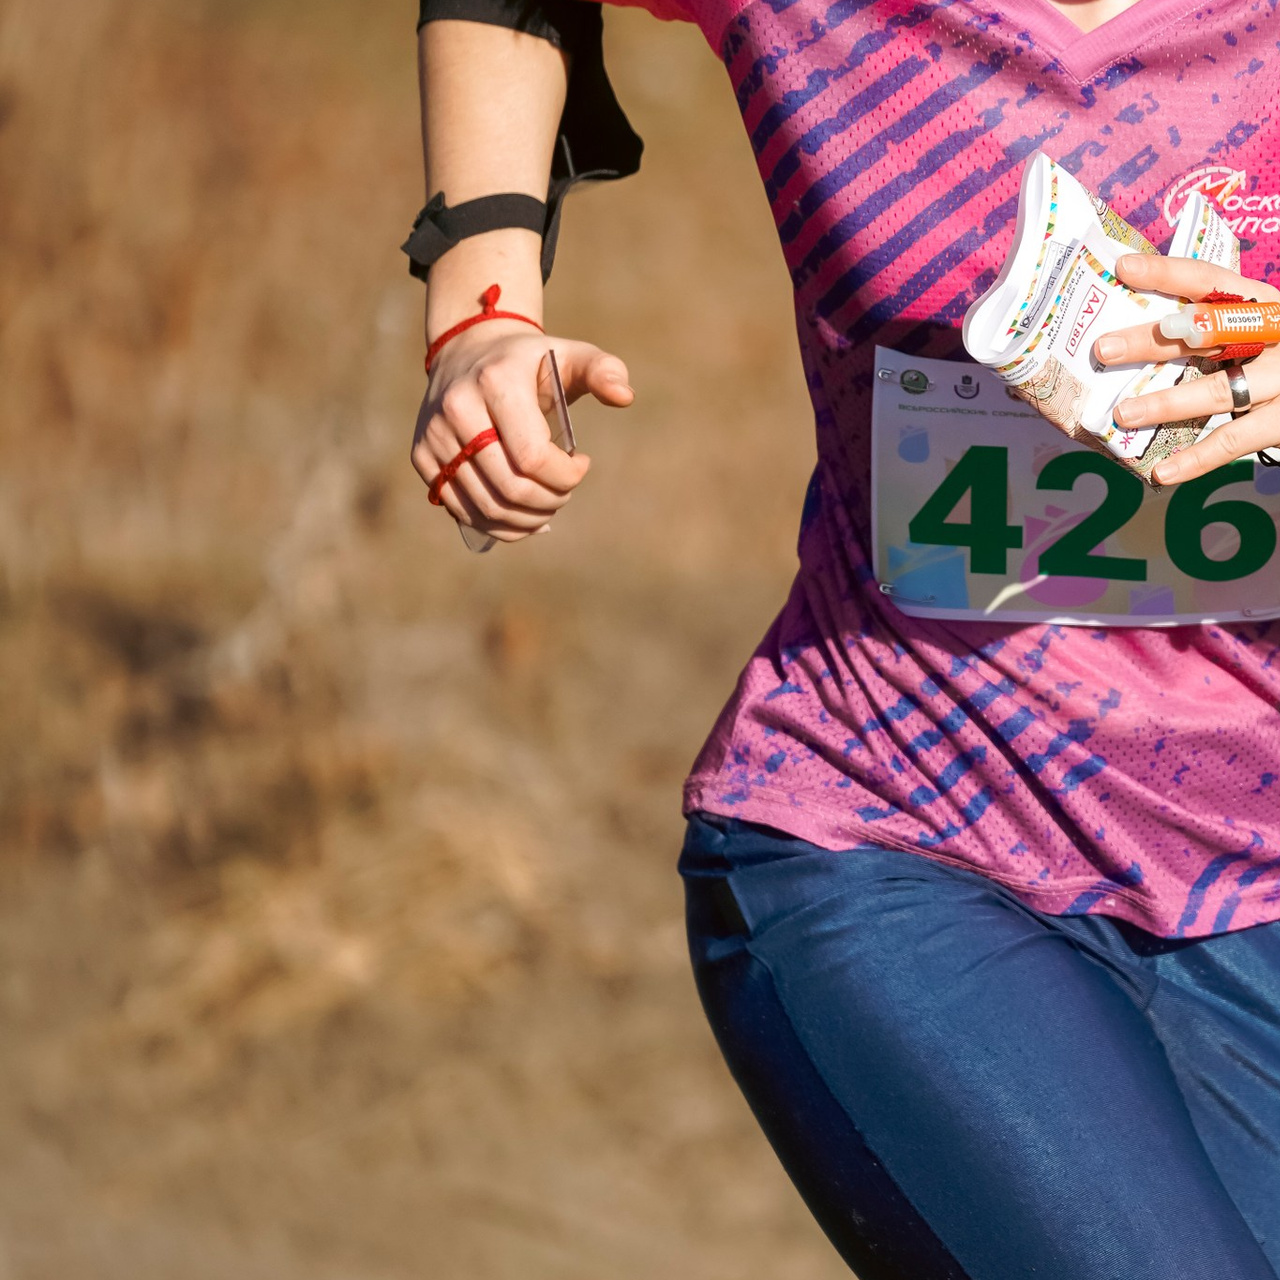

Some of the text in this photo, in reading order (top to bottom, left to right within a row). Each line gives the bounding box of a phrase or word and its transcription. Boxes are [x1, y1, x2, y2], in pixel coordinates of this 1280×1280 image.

[1227, 316, 1261, 324] 8030697
[992, 409, 1044, 419] СОРЕВНО
[909, 445, 1277, 582] 426
